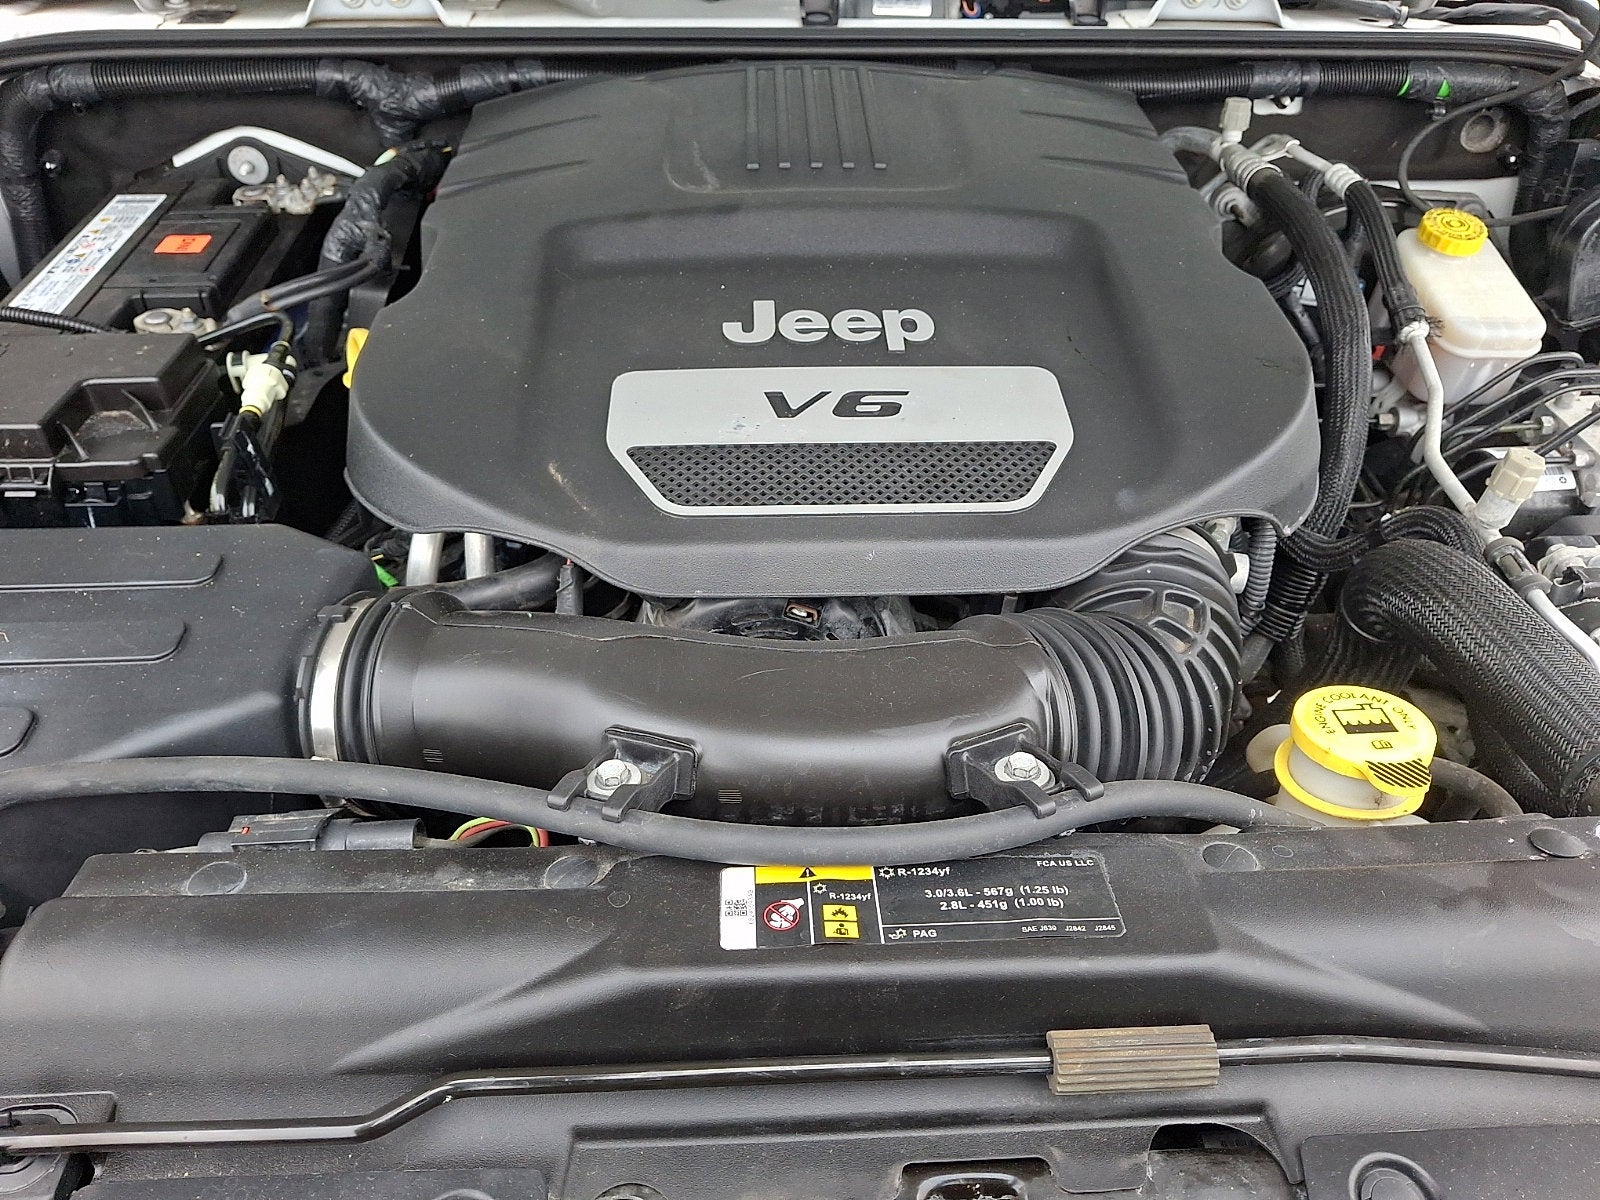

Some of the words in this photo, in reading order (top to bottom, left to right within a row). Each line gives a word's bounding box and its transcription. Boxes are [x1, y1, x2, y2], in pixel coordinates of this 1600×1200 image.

[722, 300, 935, 352] Jeep
[764, 391, 910, 418] V6
[1323, 692, 1389, 705] COOLANT
[1314, 703, 1335, 734] ENGINE
[1393, 706, 1416, 729] ONLY
[897, 867, 951, 877] R-1234yf
[829, 892, 871, 902] R-1234yf
[924, 888, 974, 898] 3.0/3.6L
[983, 887, 1014, 897] 567g
[1020, 885, 1050, 896] (1.25
[1052, 885, 1069, 896] lb)
[940, 900, 967, 911] 2.8L
[977, 900, 1008, 911] 451g
[1014, 898, 1045, 909] (1.00
[1046, 898, 1064, 909] lb)
[912, 929, 938, 938] PAG
[1022, 925, 1038, 933] SAE
[1094, 924, 1117, 932] J2845
